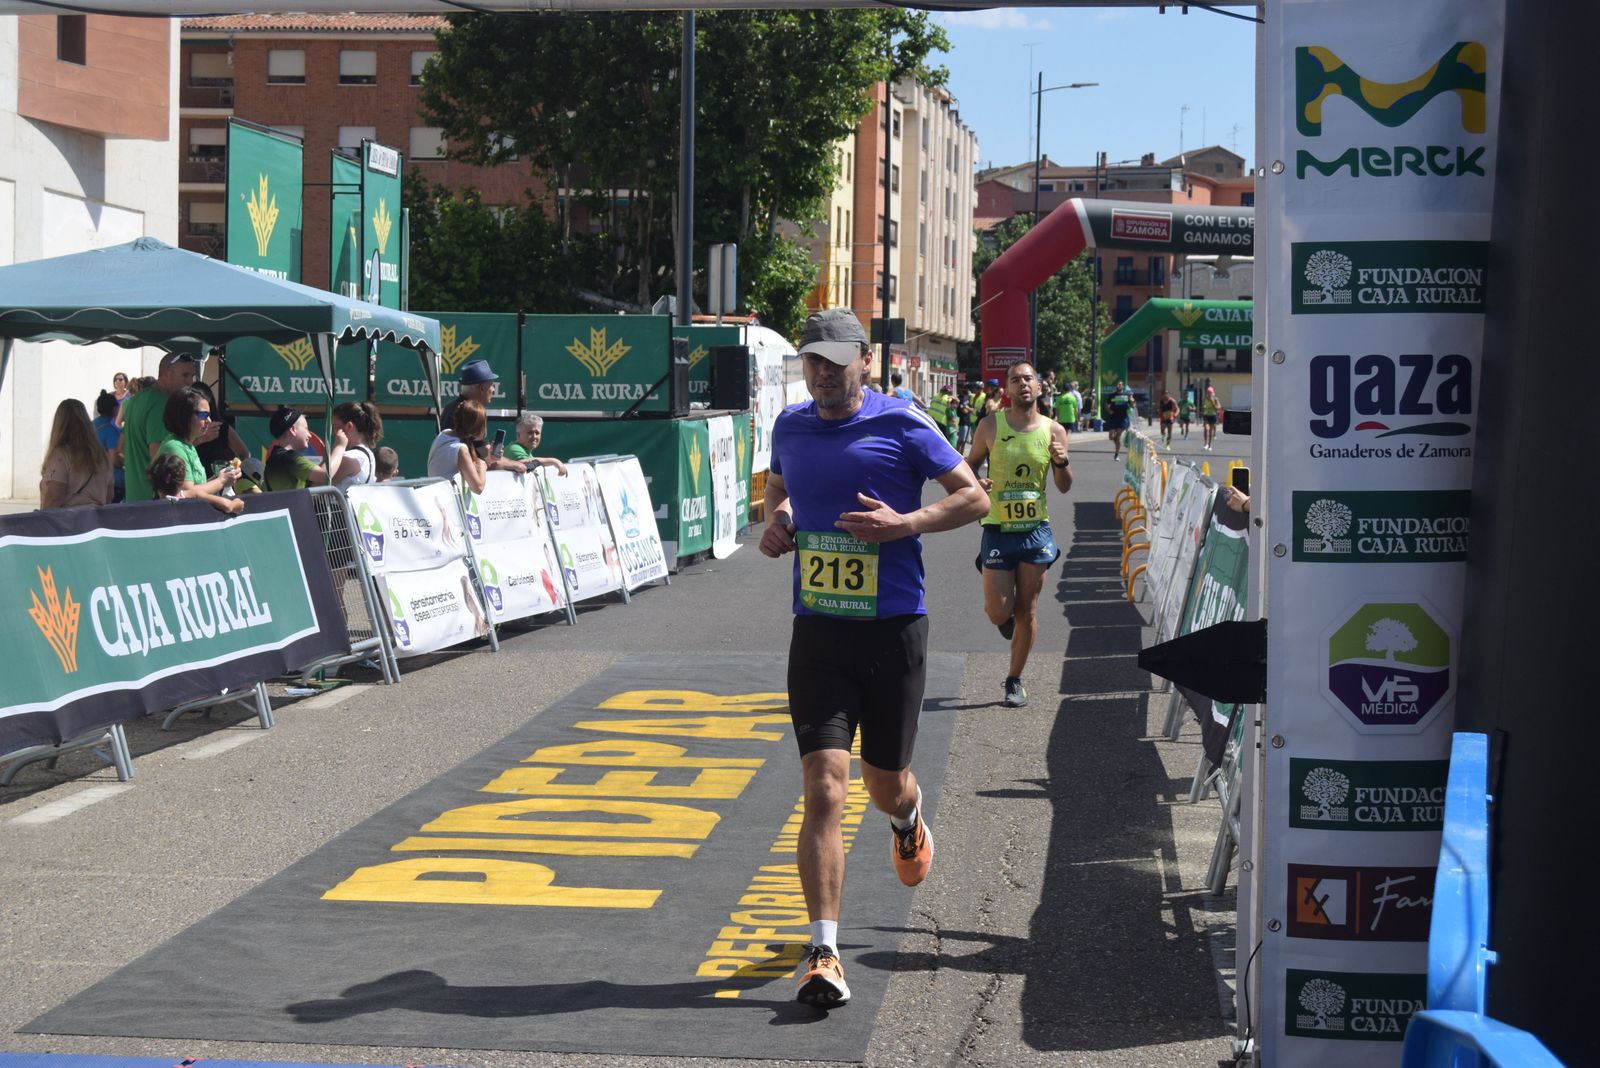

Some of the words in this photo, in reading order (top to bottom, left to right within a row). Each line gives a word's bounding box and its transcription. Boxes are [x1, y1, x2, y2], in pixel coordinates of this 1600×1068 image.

[1184, 214, 1214, 228] CON
[1218, 216, 1235, 228] EL
[1126, 226, 1168, 237] ZAMORA
[1184, 231, 1252, 245] GANAMOS
[1358, 267, 1483, 286] FUNDACION
[1358, 287, 1411, 305] CAJA
[1416, 287, 1482, 304] RURAL
[1205, 308, 1242, 322] CAJA
[240, 375, 284, 394] CAJA
[387, 379, 434, 397] CAJA
[539, 383, 586, 401] CAJA
[591, 382, 659, 401] RURAL
[1309, 354, 1472, 439] gaza
[1309, 443, 1392, 459] Ganaderos
[1396, 443, 1415, 459] de
[1419, 443, 1472, 458] Zamora
[1004, 480, 1035, 489] Adarsa
[1004, 502, 1037, 520] 196
[820, 543, 838, 552] CAJA
[840, 544, 868, 553] RURAL
[1358, 537, 1409, 555] CAJA
[809, 556, 864, 591] 213
[90, 582, 175, 657] CAJA
[166, 566, 273, 643] RURAL
[818, 598, 839, 608] CAJA
[840, 600, 872, 610] RURAL
[1354, 806, 1405, 824] CAJA
[1351, 1016, 1402, 1034] CAJA
